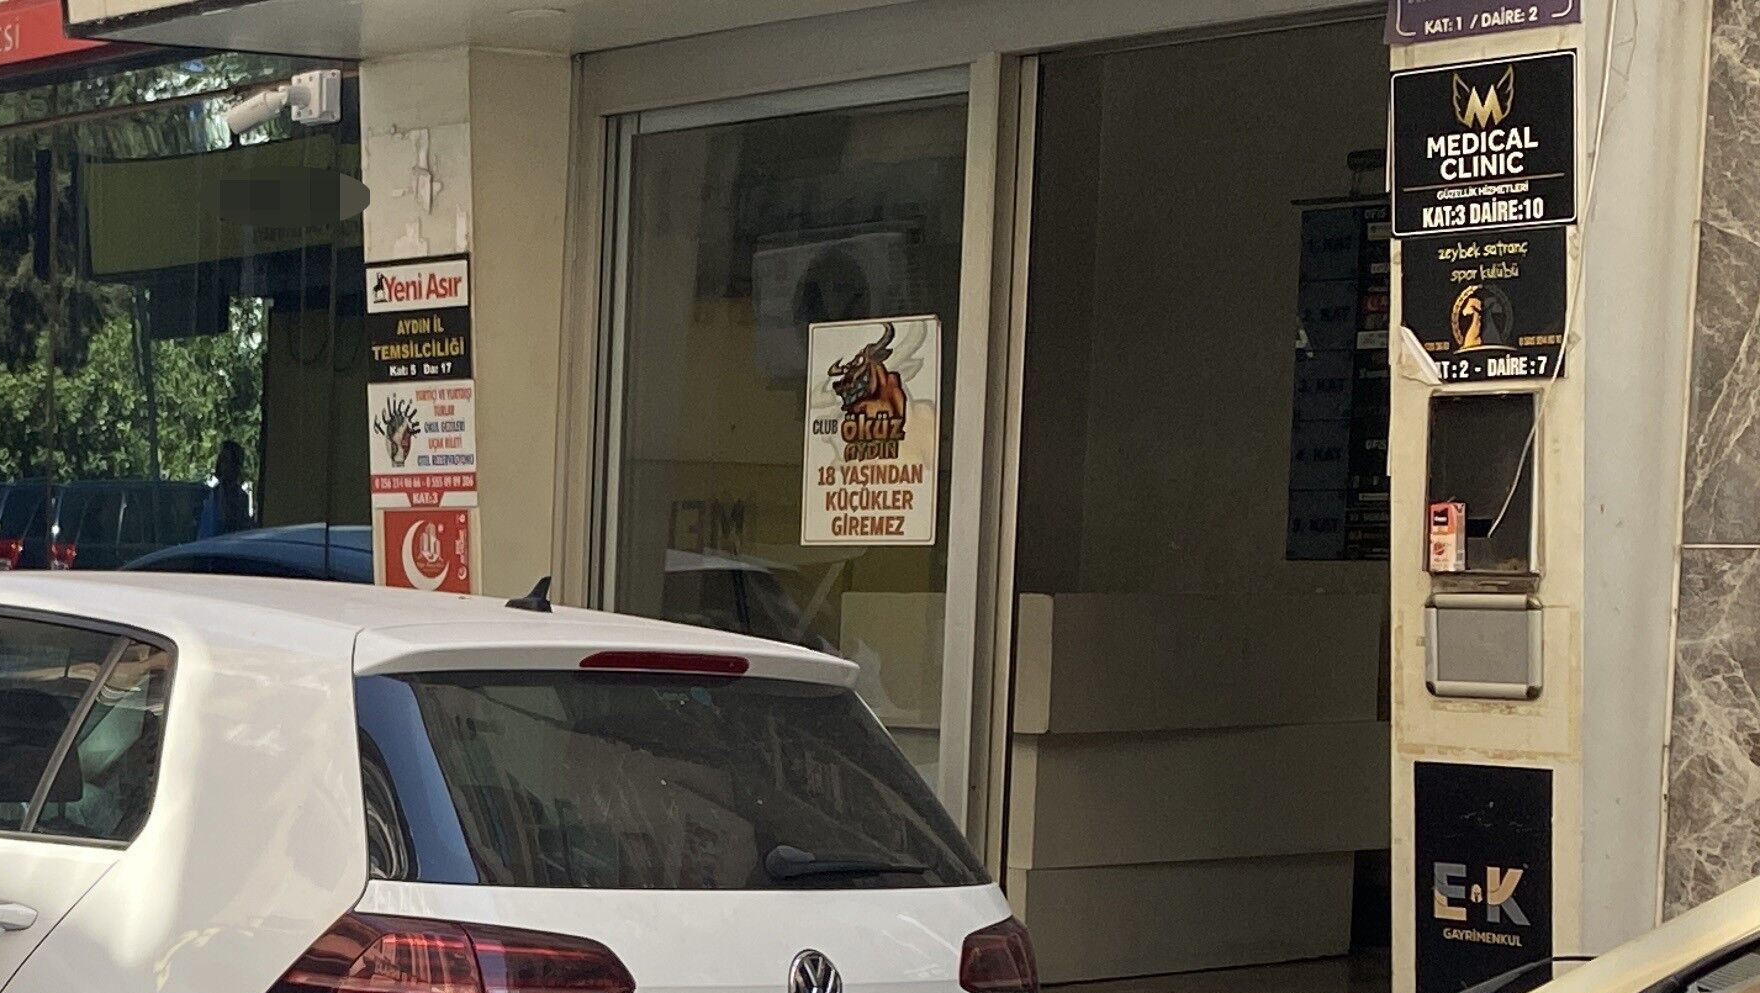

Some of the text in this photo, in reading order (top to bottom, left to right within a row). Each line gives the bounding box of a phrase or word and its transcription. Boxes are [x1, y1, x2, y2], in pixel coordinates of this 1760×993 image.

[1456, 17, 1462, 30] 1
[1528, 6, 1538, 21] 2
[1426, 126, 1539, 158] MEDICAL
[1440, 151, 1524, 180] CLINIC
[1422, 197, 1544, 228] KAT:3 DAİRE:10
[1438, 240, 1528, 263] zeybek satranç
[383, 272, 462, 302] Yeni Asır
[1449, 268, 1478, 284] spor
[397, 317, 430, 335] AYDIN
[372, 336, 465, 360] TEMSİLCİLİĞİ
[441, 362, 452, 374] 17
[812, 419, 838, 435] CLUB
[844, 441, 899, 462] AYDIN
[818, 464, 923, 490] 18 YAŞINDAN
[825, 487, 914, 513] KÜÇÜKLER
[831, 513, 905, 536] GİREMEZ
[1443, 927, 1522, 947] GAYRİMENKUL
